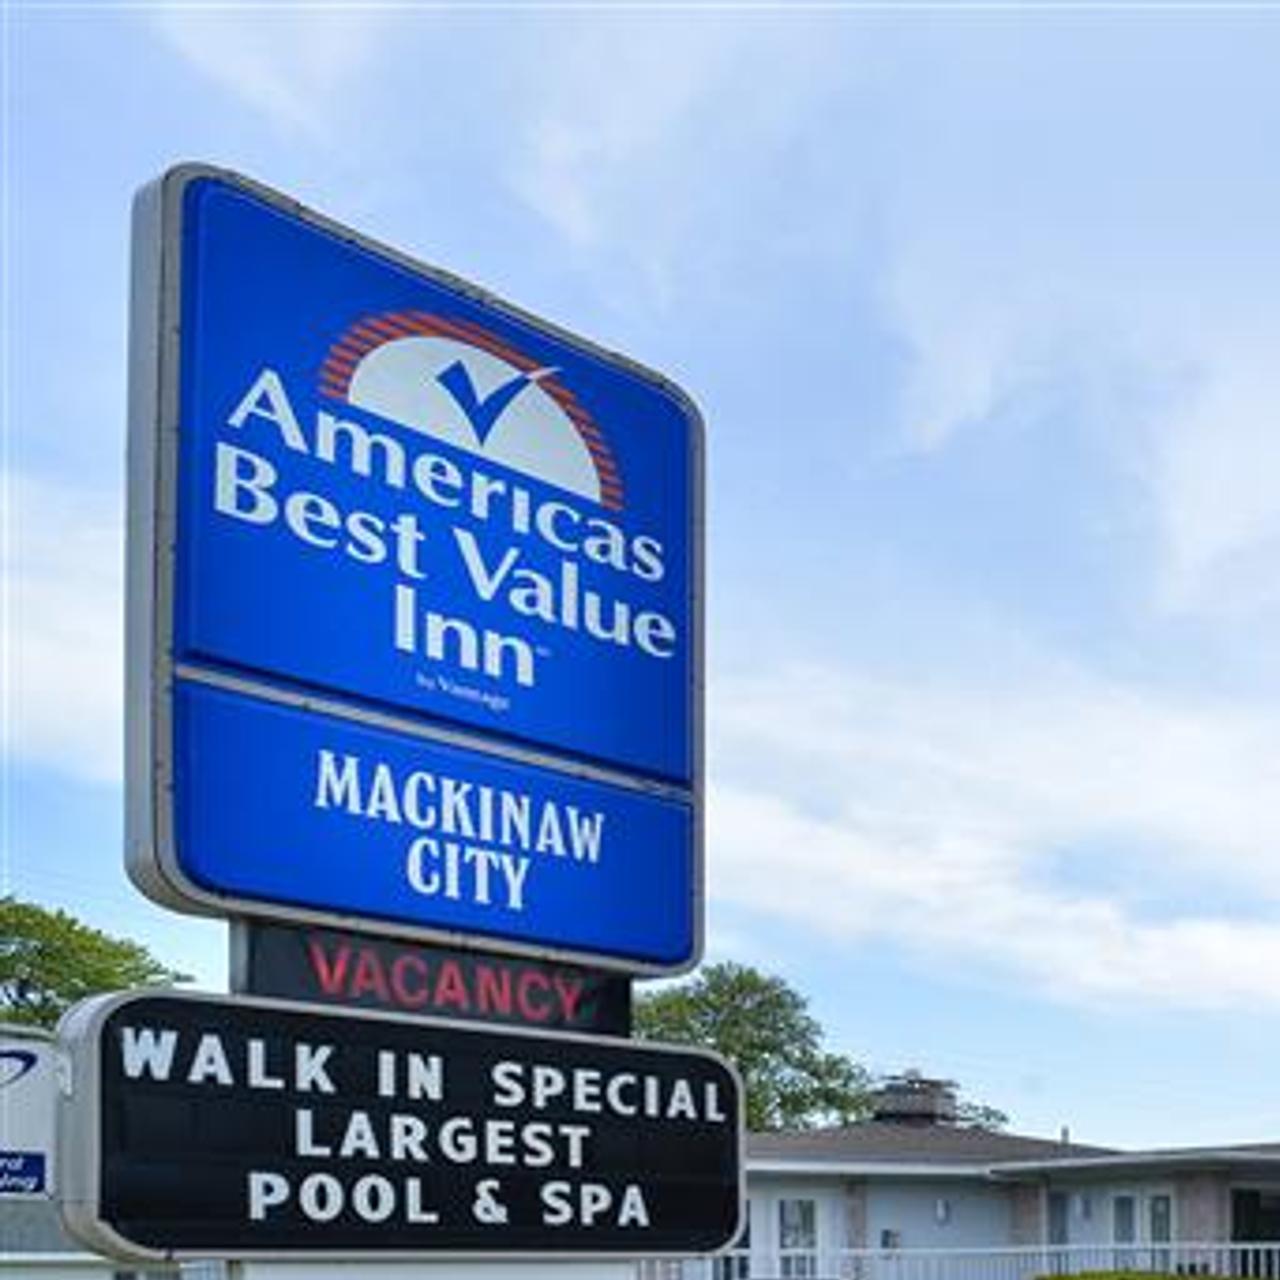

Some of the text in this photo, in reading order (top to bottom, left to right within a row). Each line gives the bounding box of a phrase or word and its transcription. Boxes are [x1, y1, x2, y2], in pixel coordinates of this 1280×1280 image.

[227, 368, 665, 582] Americas
[213, 441, 678, 658] Best Value
[394, 584, 536, 687] Inn
[313, 749, 605, 864] MACKINAW
[407, 836, 529, 910] CITY
[310, 945, 585, 1022] VACANCY
[120, 1027, 727, 1124] WALK IN SPECIAL
[296, 1109, 593, 1169] LARGEST
[248, 1171, 650, 1227] POOL & SPA
